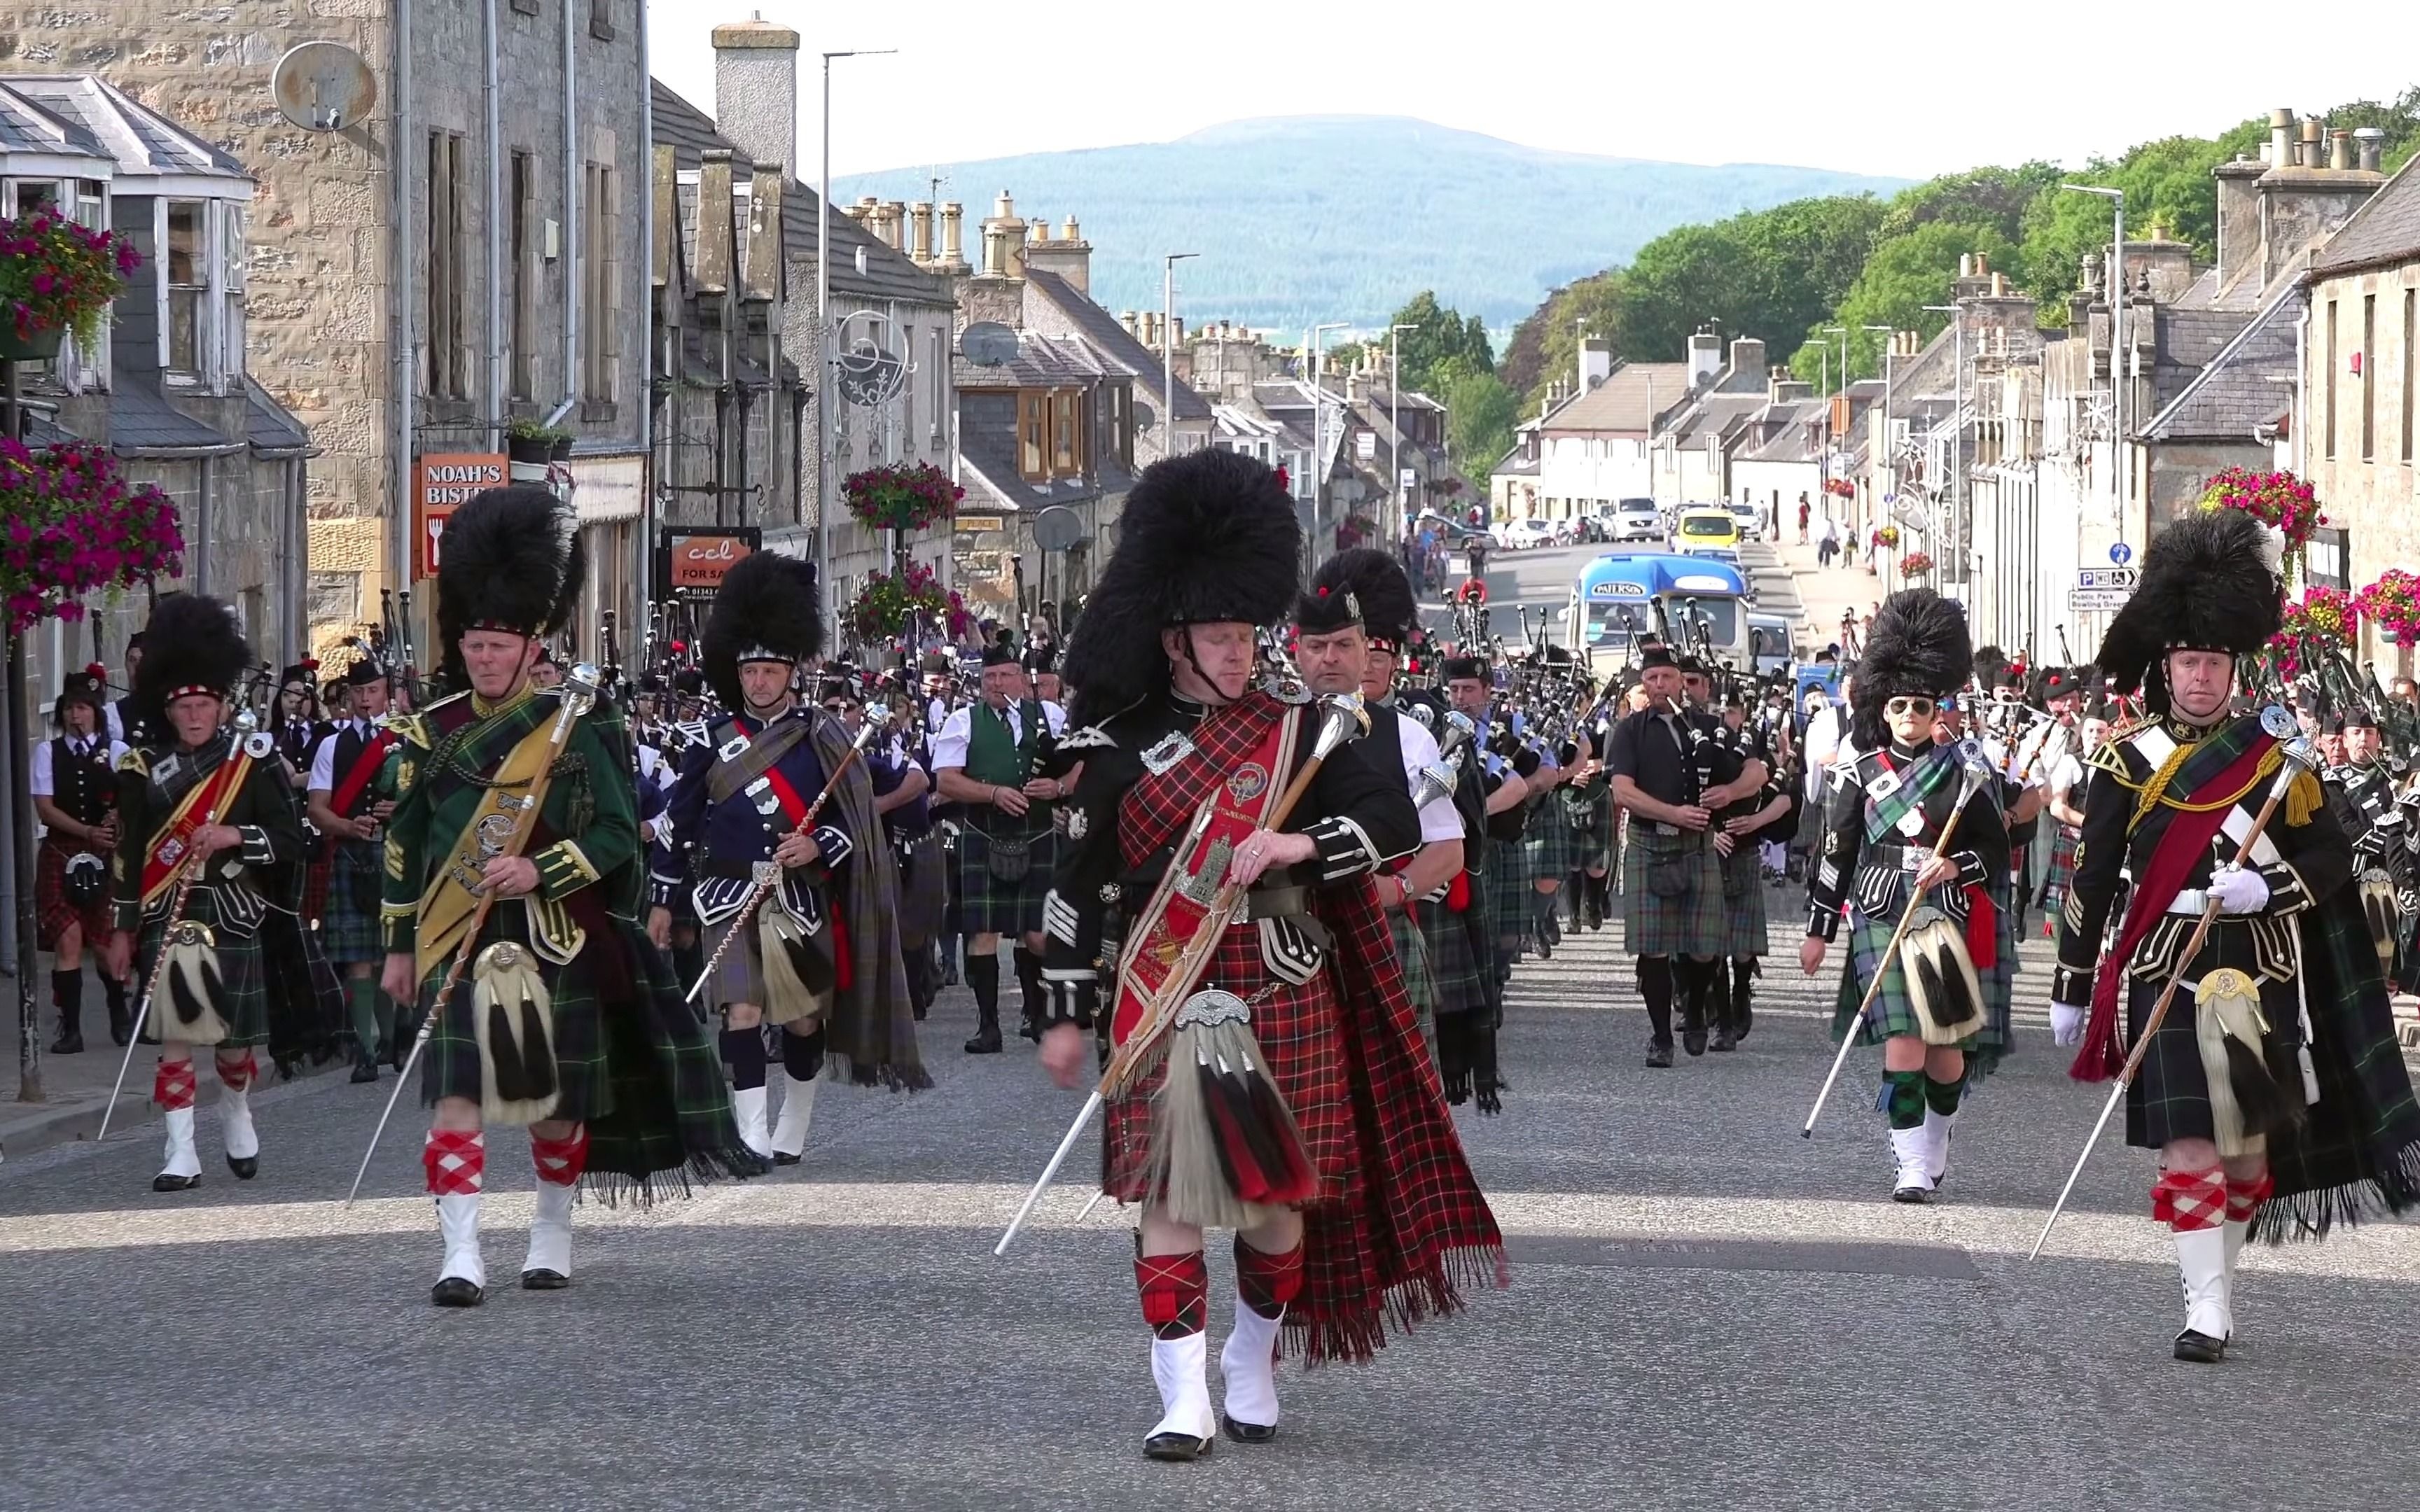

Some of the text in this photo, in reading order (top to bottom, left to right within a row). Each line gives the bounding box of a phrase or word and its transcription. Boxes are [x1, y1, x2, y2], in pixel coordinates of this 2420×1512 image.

[427, 465, 501, 483] NOAH'S
[426, 487, 487, 505] BIST
[682, 570, 724, 579] FOR SA
[1597, 584, 1641, 595] PATERSON
